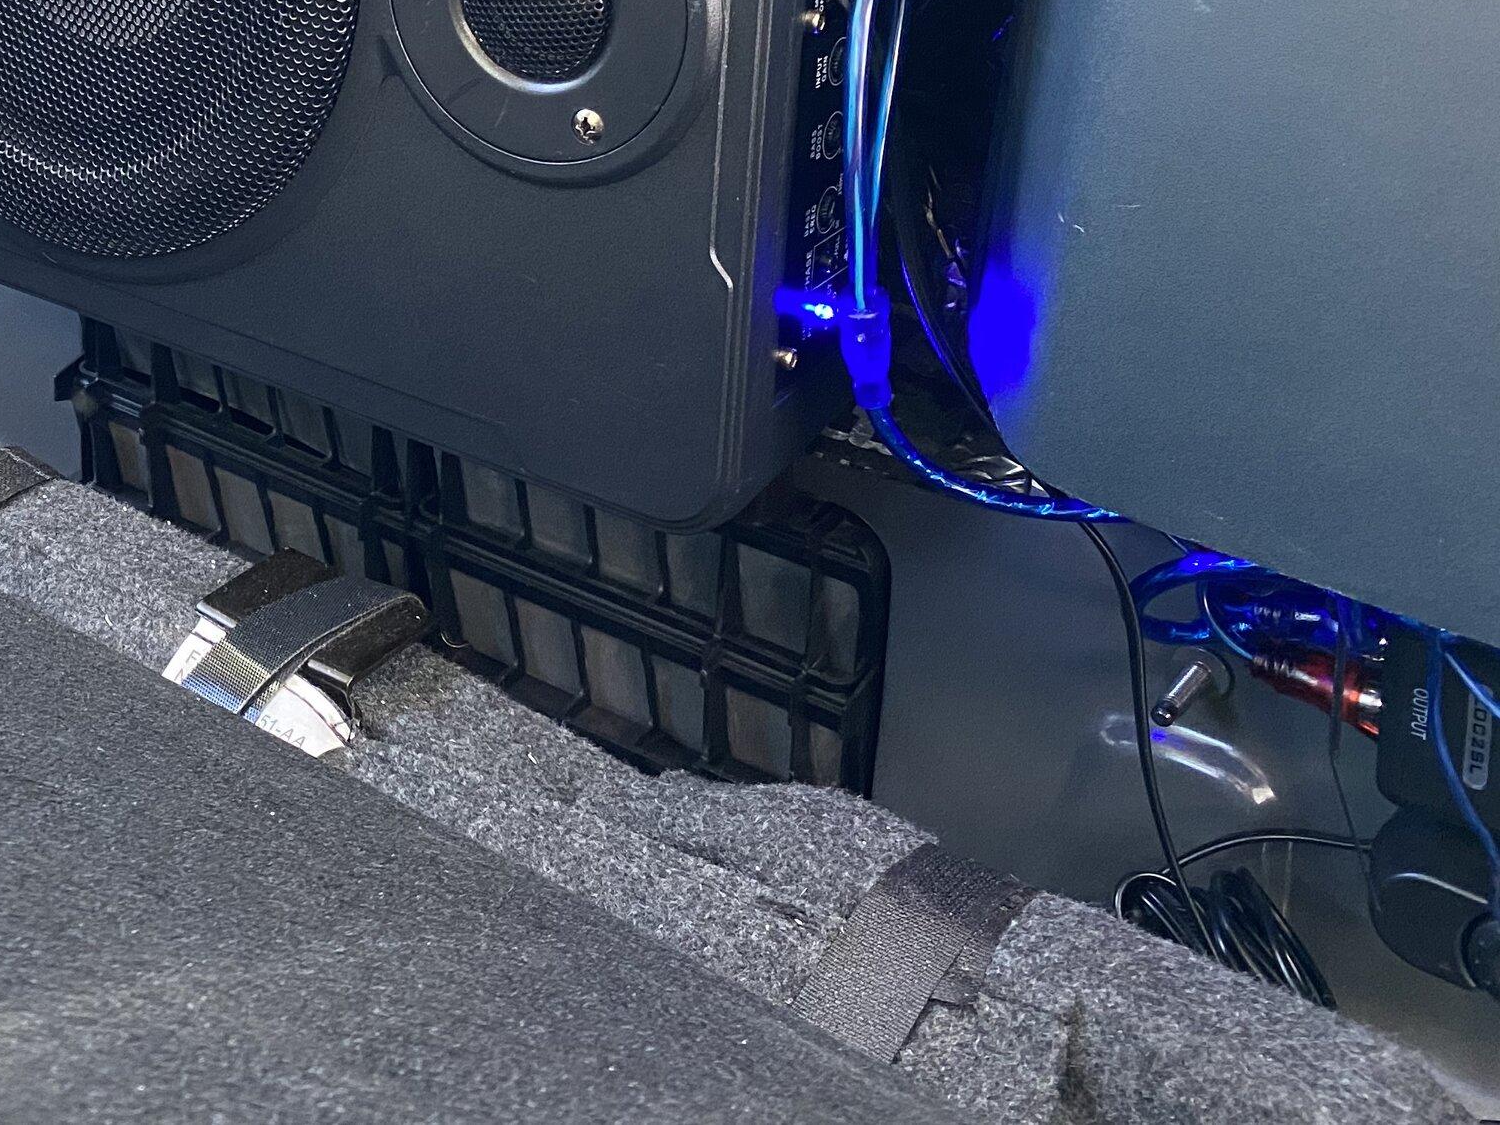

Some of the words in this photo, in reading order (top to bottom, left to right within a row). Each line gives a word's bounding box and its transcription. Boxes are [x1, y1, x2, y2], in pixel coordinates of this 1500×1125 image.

[815, 57, 824, 89] INPUT
[821, 55, 829, 83] GAIN
[1411, 687, 1429, 742] OUTPUT
